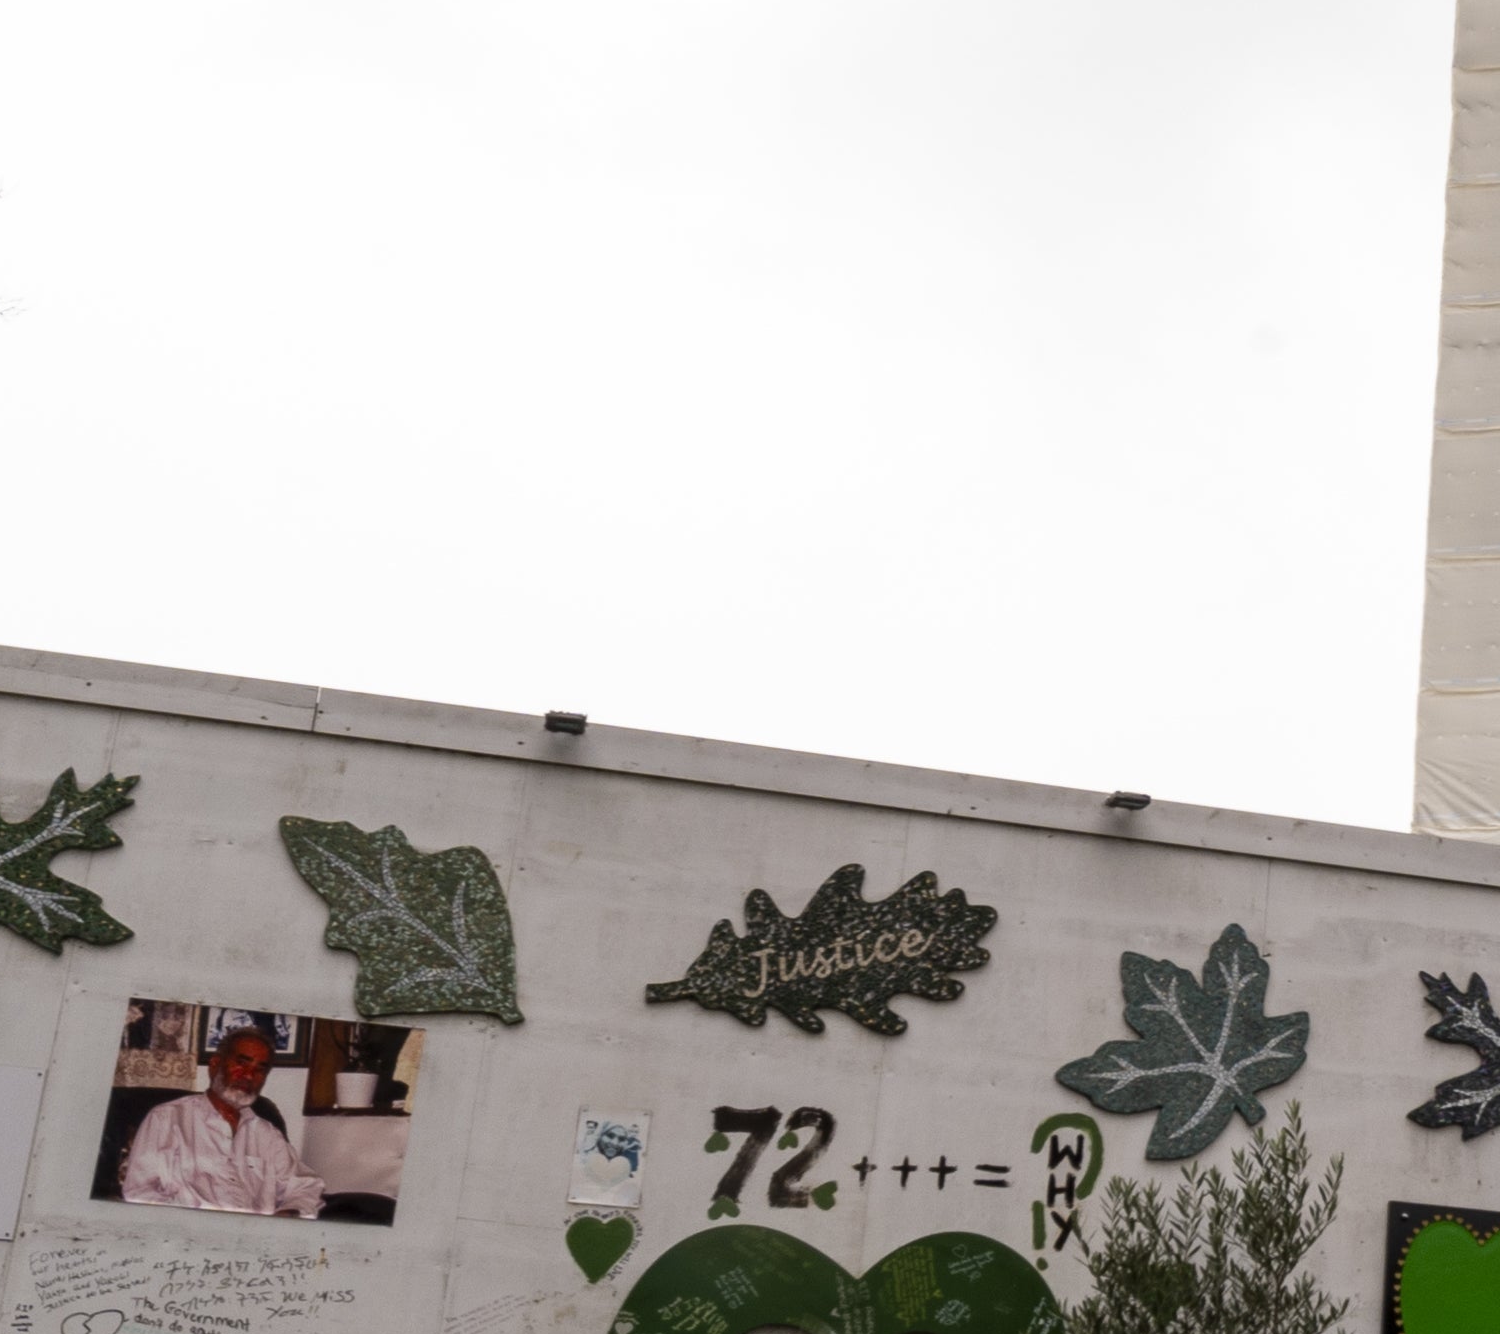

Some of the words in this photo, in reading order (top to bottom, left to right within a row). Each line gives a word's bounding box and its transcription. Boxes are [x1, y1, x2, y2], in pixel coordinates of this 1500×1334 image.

[744, 928, 938, 999] Justice
[710, 1105, 837, 1208] 72
[130, 1296, 161, 1313] The
[163, 1300, 251, 1332] Government
